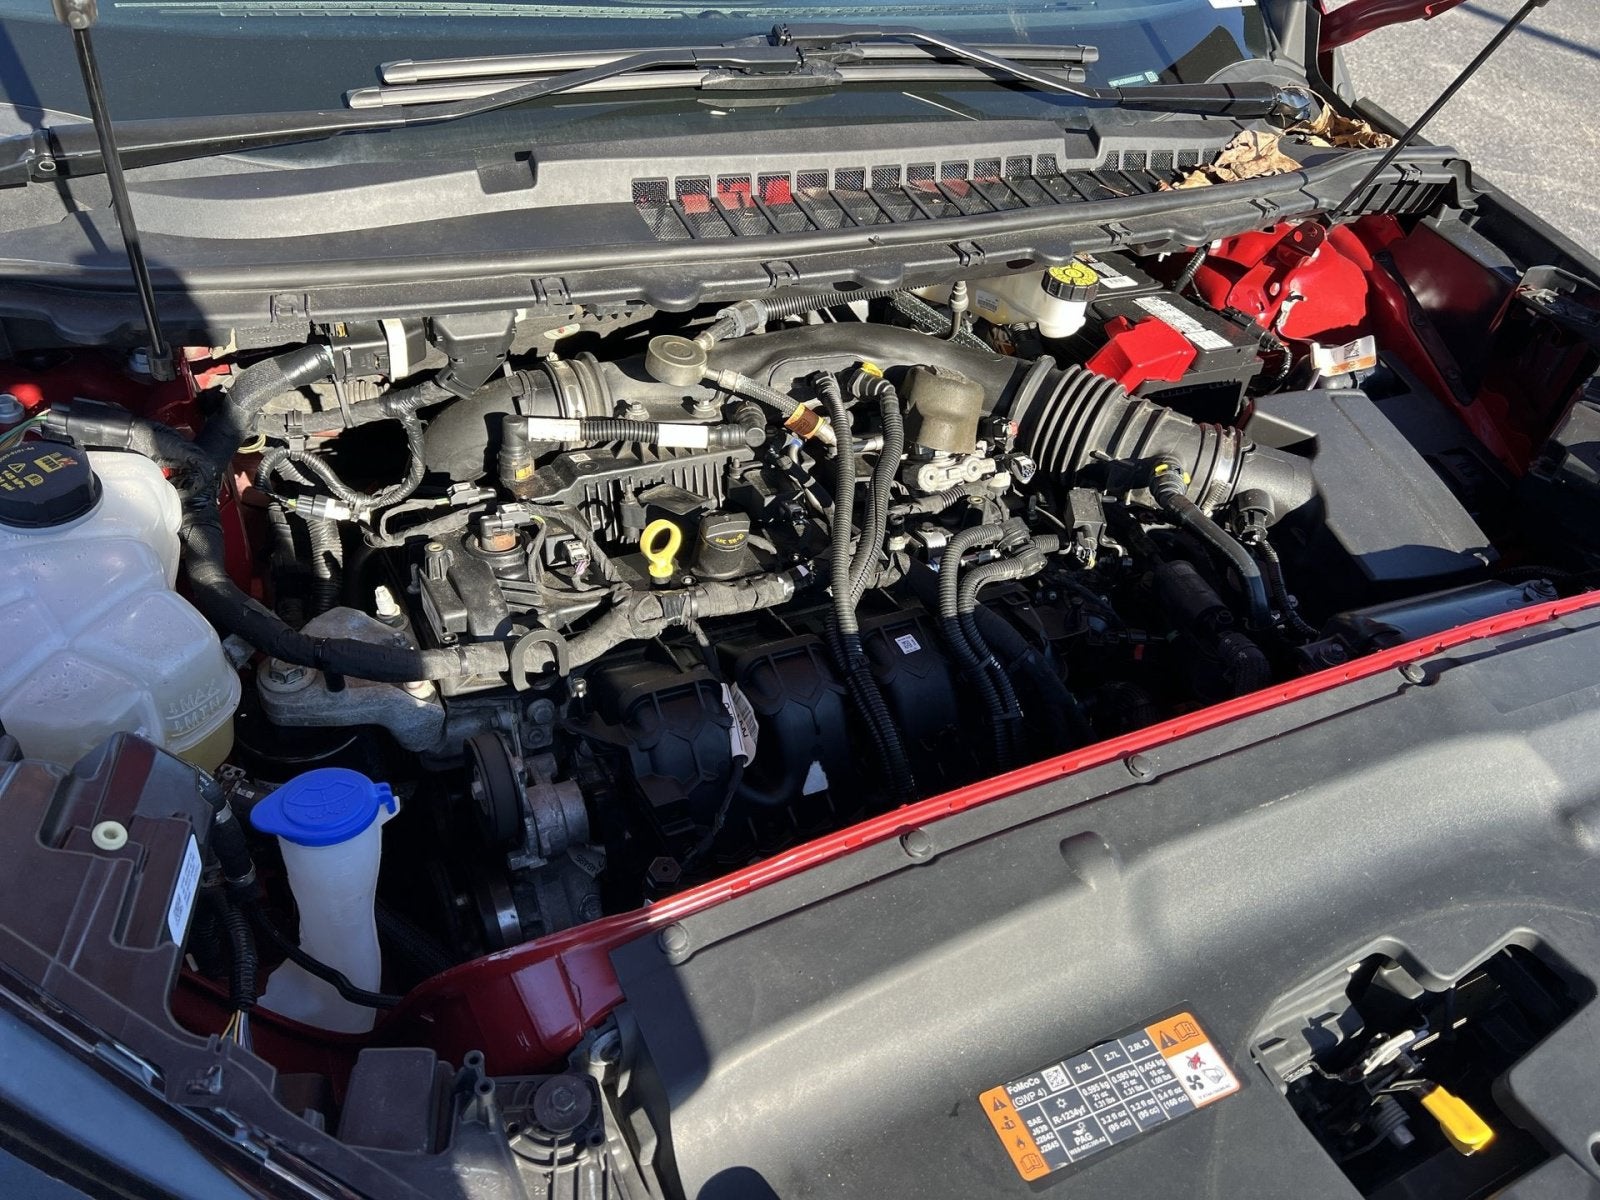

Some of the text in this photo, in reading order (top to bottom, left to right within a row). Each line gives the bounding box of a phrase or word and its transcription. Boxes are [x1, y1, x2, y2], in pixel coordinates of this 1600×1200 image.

[1104, 1051, 1120, 1061] 2.7L
[1007, 1078, 1040, 1094] FoMoCo
[1099, 1081, 1110, 1089] kg
[1123, 1087, 1135, 1096] 1.31
[1012, 1088, 1047, 1108] (GWP 4)
[1178, 1094, 1189, 1103] cc)
[1094, 1100, 1106, 1108] 1.31
[1130, 1102, 1142, 1112] 3.2
[1052, 1105, 1086, 1124] R-1234yf
[1138, 1106, 1160, 1120] (95 cc)
[1027, 1116, 1043, 1127] SAE
[1100, 1115, 1112, 1124] 3.2
[1033, 1124, 1048, 1136] J639
[1108, 1118, 1132, 1133] (95 cc)
[1074, 1132, 1093, 1145] PAG
